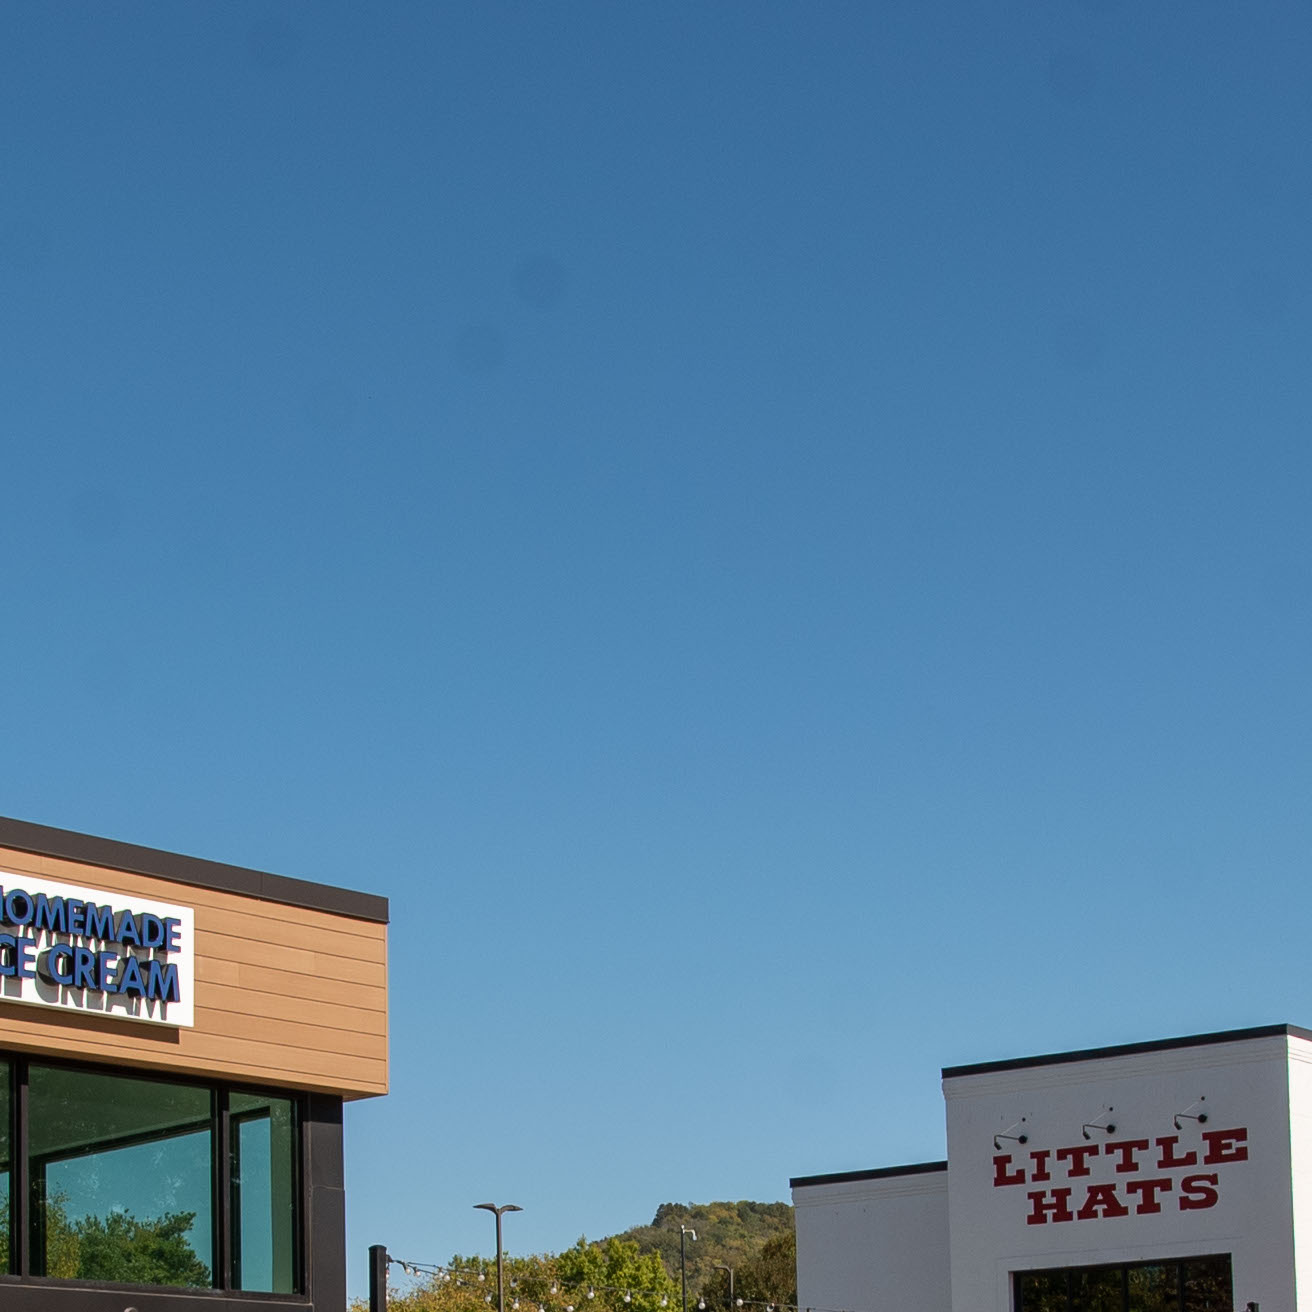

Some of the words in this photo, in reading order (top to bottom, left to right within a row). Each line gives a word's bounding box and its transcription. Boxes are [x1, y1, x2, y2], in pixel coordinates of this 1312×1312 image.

[47, 942, 181, 1002] CREAM
[992, 1127, 1249, 1188] LITTLE
[1026, 1172, 1220, 1226] HATS
